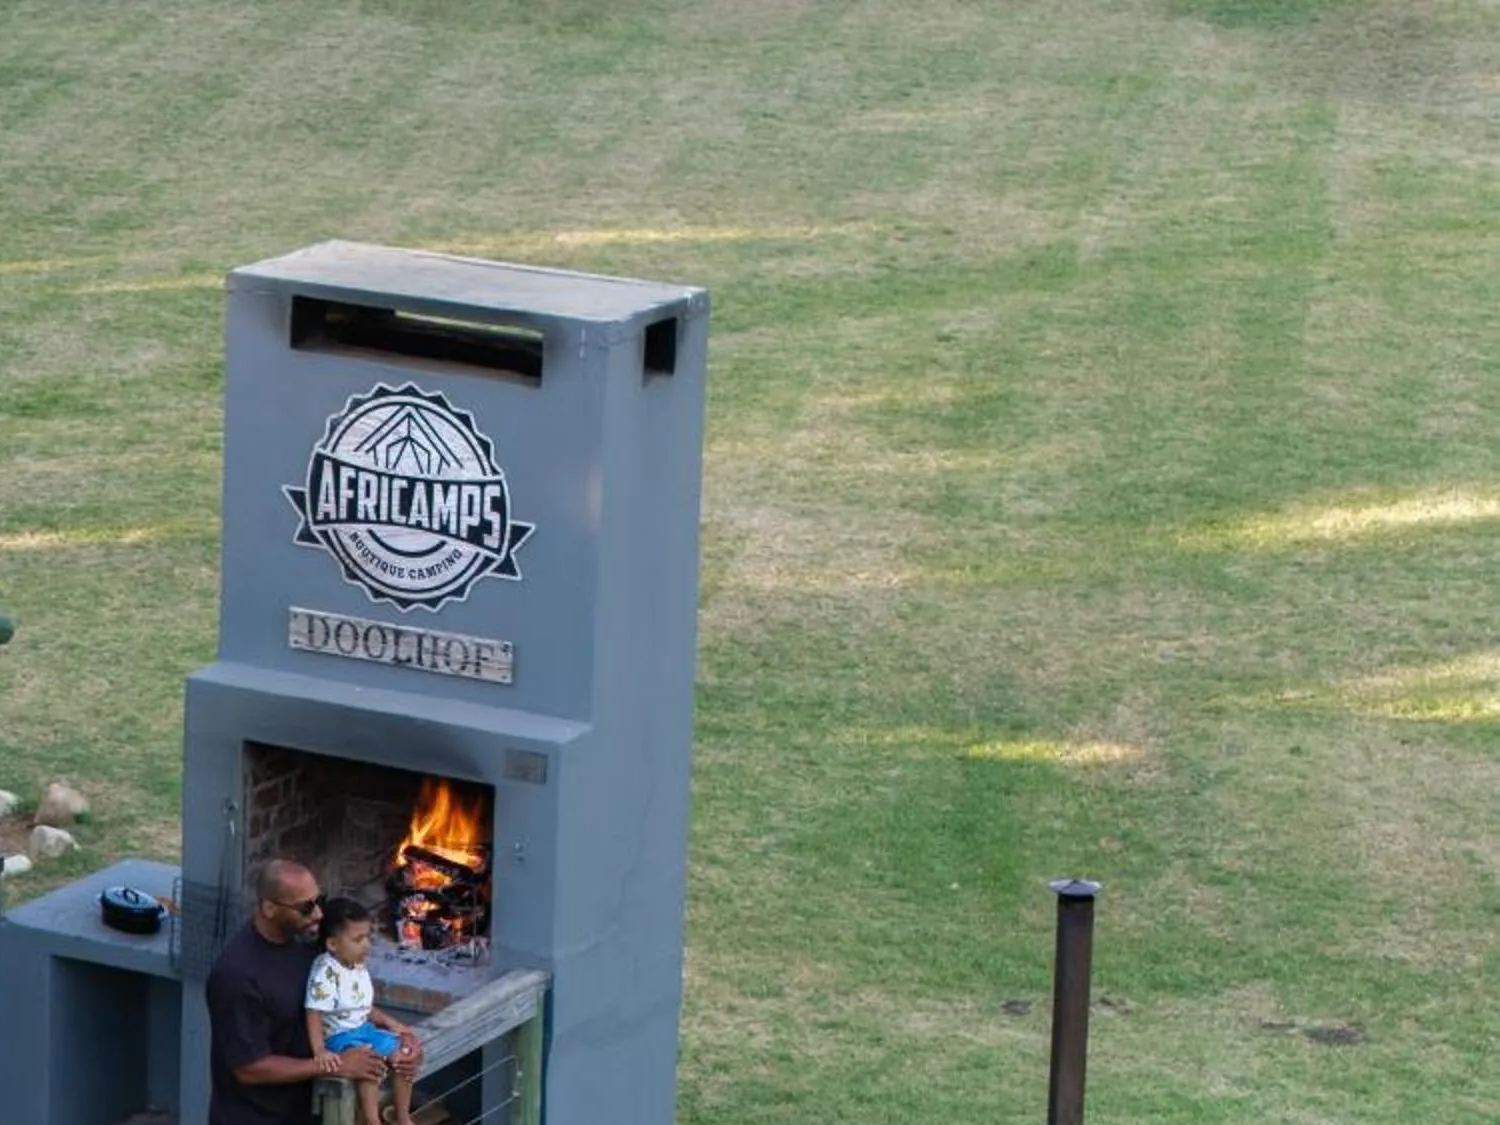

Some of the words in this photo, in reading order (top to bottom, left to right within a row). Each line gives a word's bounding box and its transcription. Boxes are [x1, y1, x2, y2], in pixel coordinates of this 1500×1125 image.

[317, 460, 501, 548] AFRICAMPS
[349, 532, 405, 579] BOUTIQUE
[407, 548, 463, 580] CAMPING
[306, 614, 495, 674] DOOLHOF
